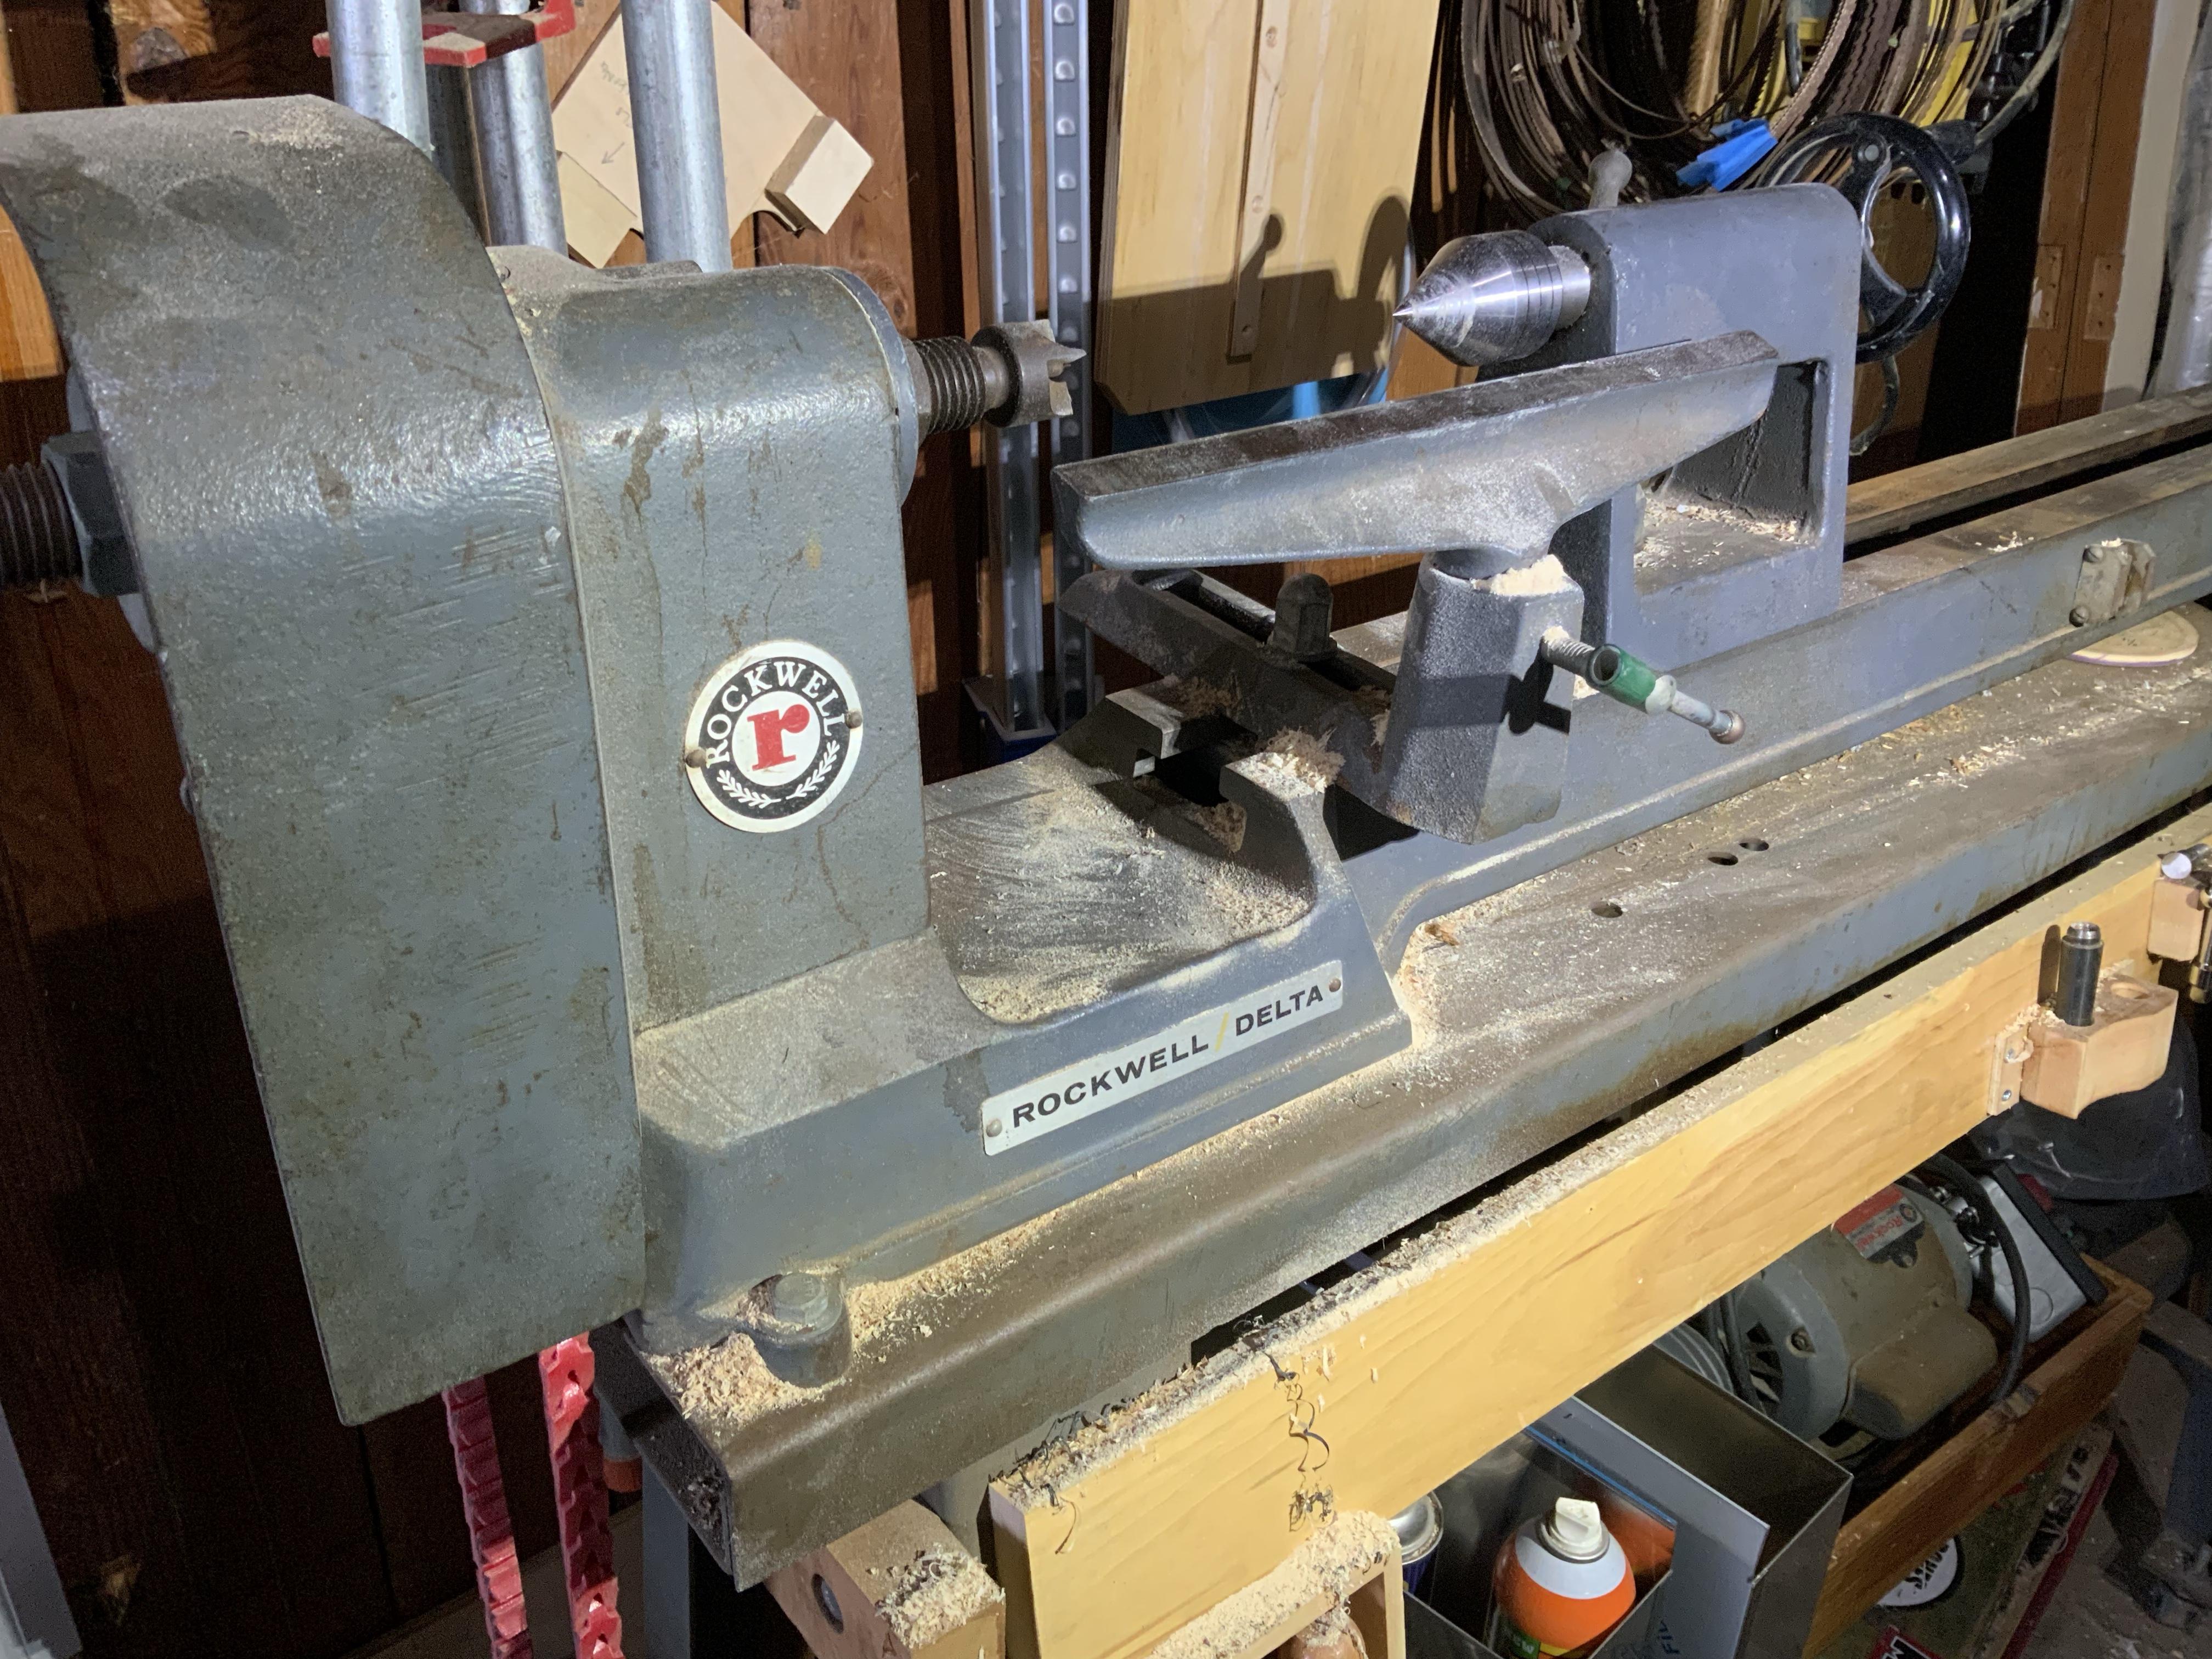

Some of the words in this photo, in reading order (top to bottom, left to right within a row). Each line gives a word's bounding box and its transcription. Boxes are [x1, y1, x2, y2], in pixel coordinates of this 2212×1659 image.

[706, 661, 845, 769] ROCKWELL
[747, 704, 810, 771] r
[1012, 1035, 1209, 1128] ROCKWELL
[1235, 985, 1323, 1037] DELTA
